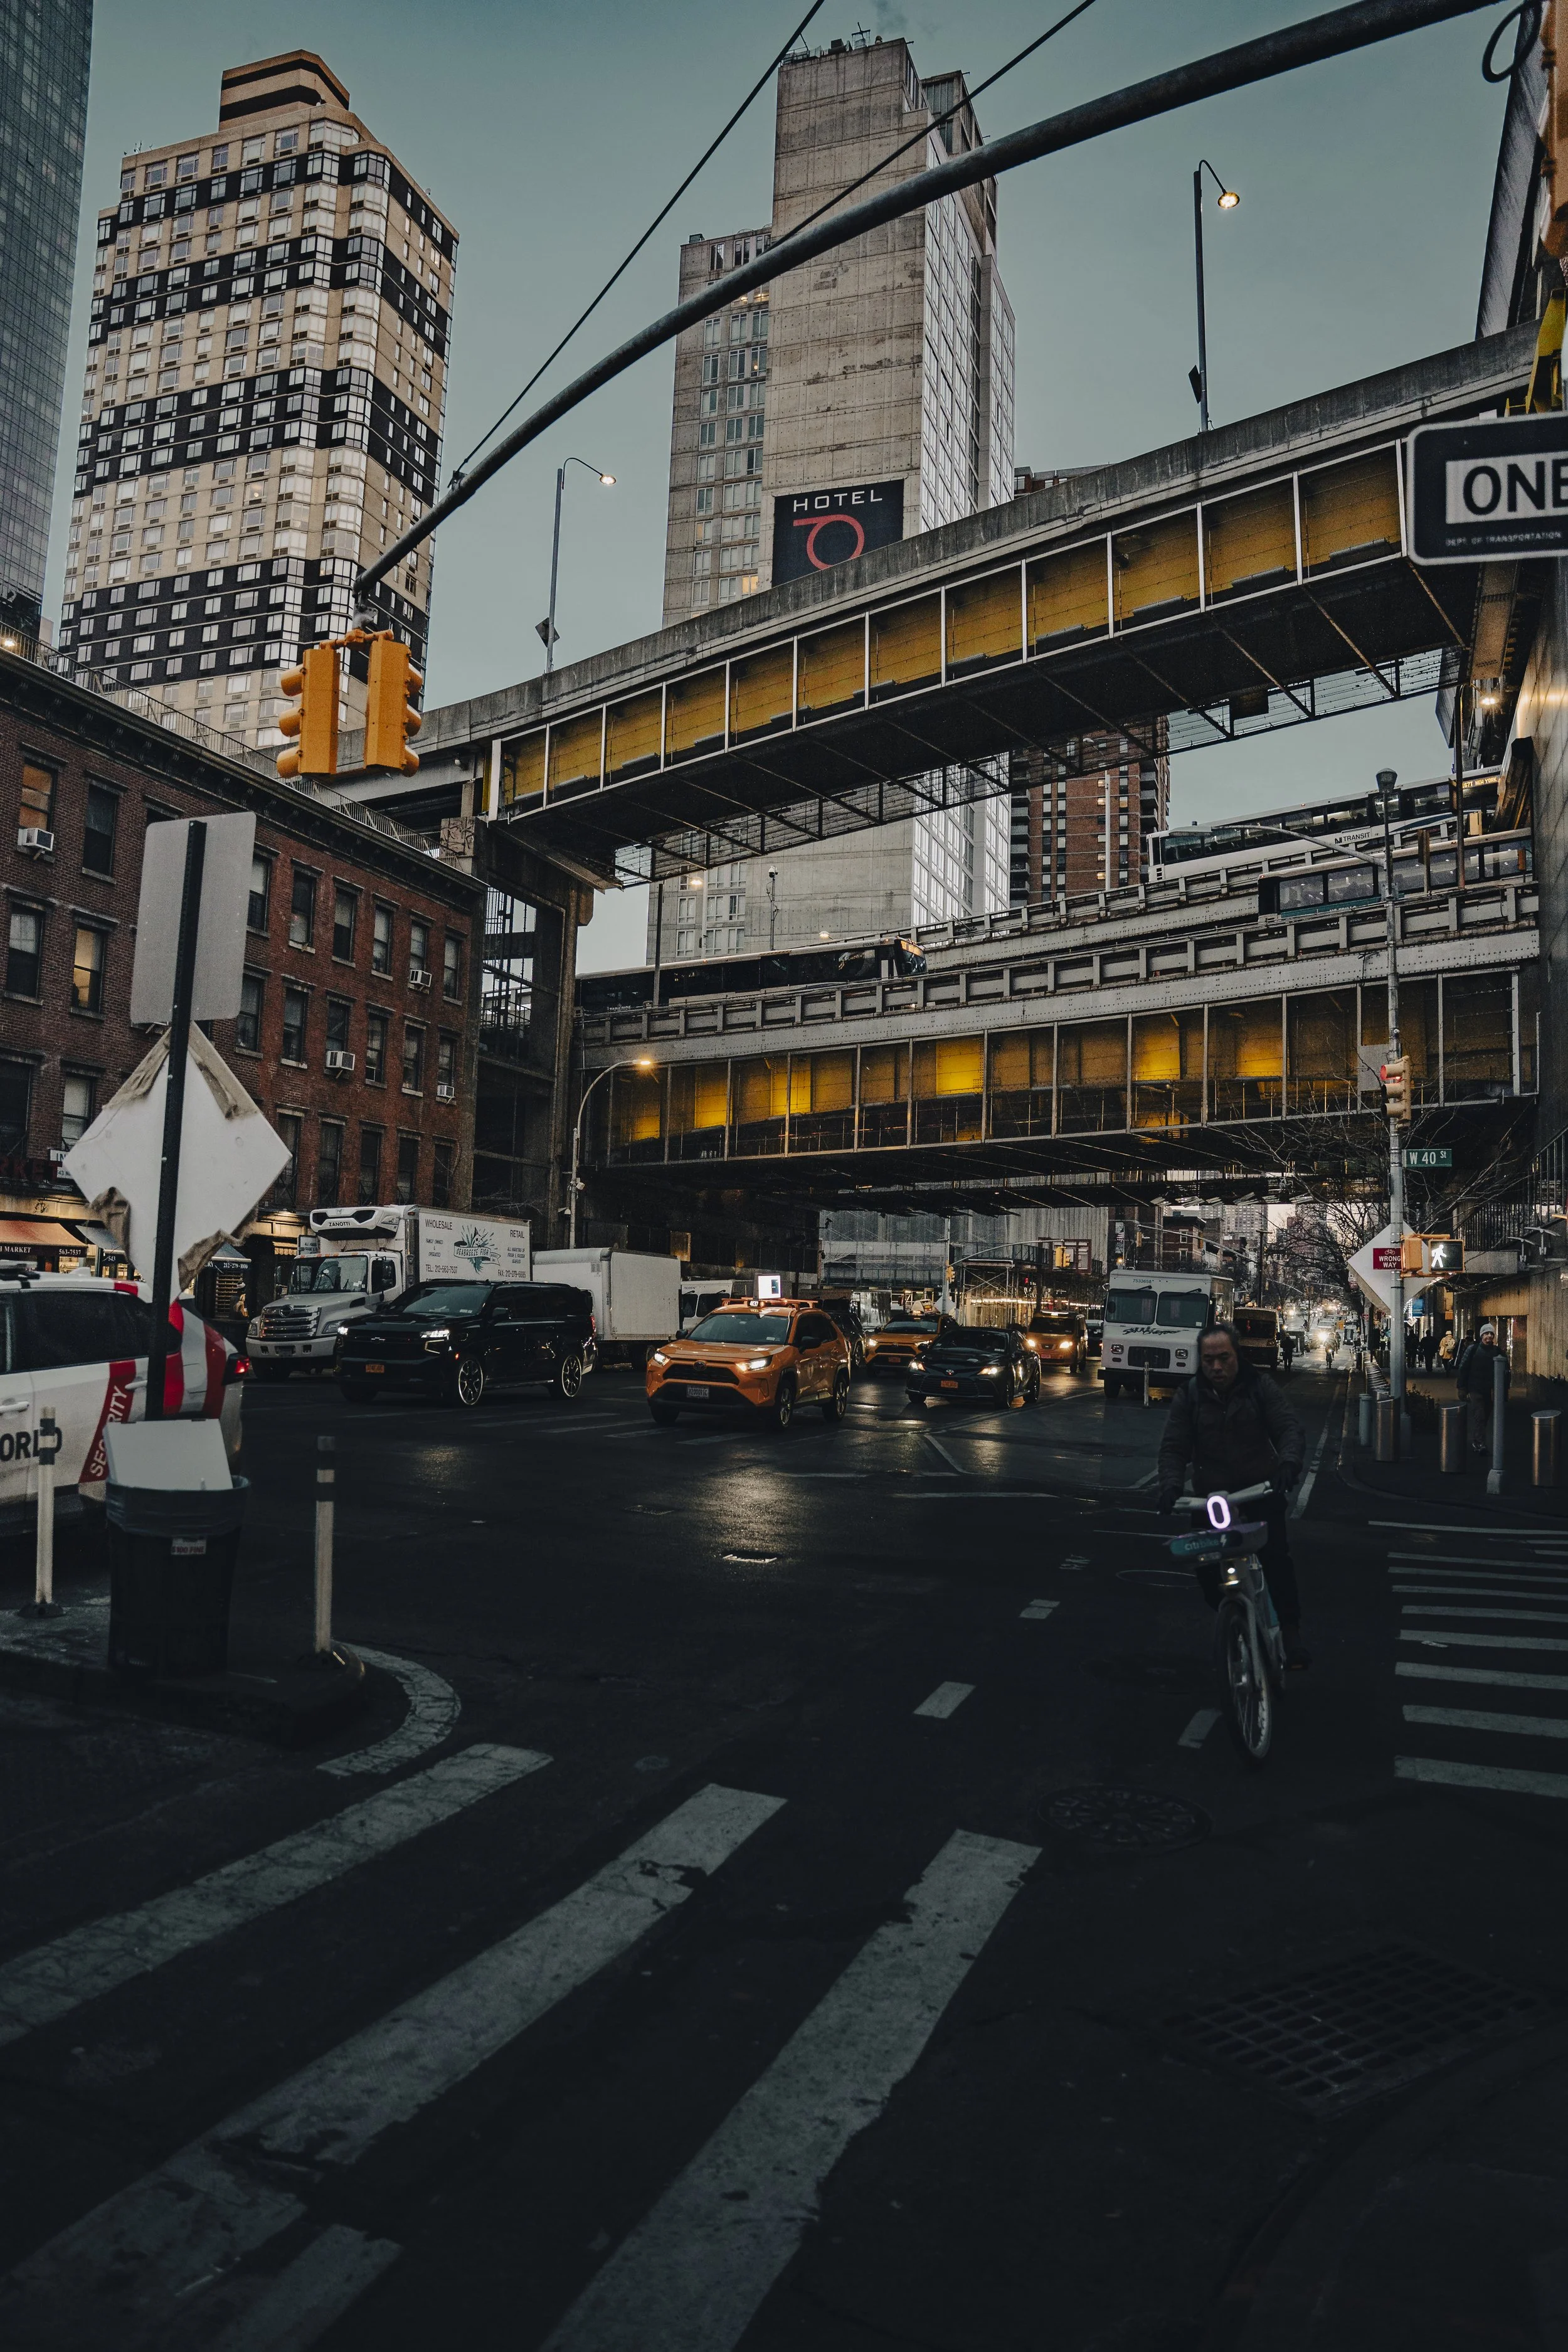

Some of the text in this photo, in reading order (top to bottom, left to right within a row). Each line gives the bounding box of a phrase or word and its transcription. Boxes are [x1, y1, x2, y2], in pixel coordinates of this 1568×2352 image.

[793, 489, 882, 512] HOTEL
[1485, 531, 1562, 543] TRANSPORTATION
[1343, 832, 1370, 842] TRANSIT
[1410, 1150, 1446, 1165] W 40 St
[425, 1219, 453, 1230] WHOLESALE
[510, 1229, 525, 1239] RETAIL
[456, 1248, 478, 1256] SEABREEZE
[480, 1248, 489, 1256] FISH
[435, 1264, 458, 1274] 212-563-7537
